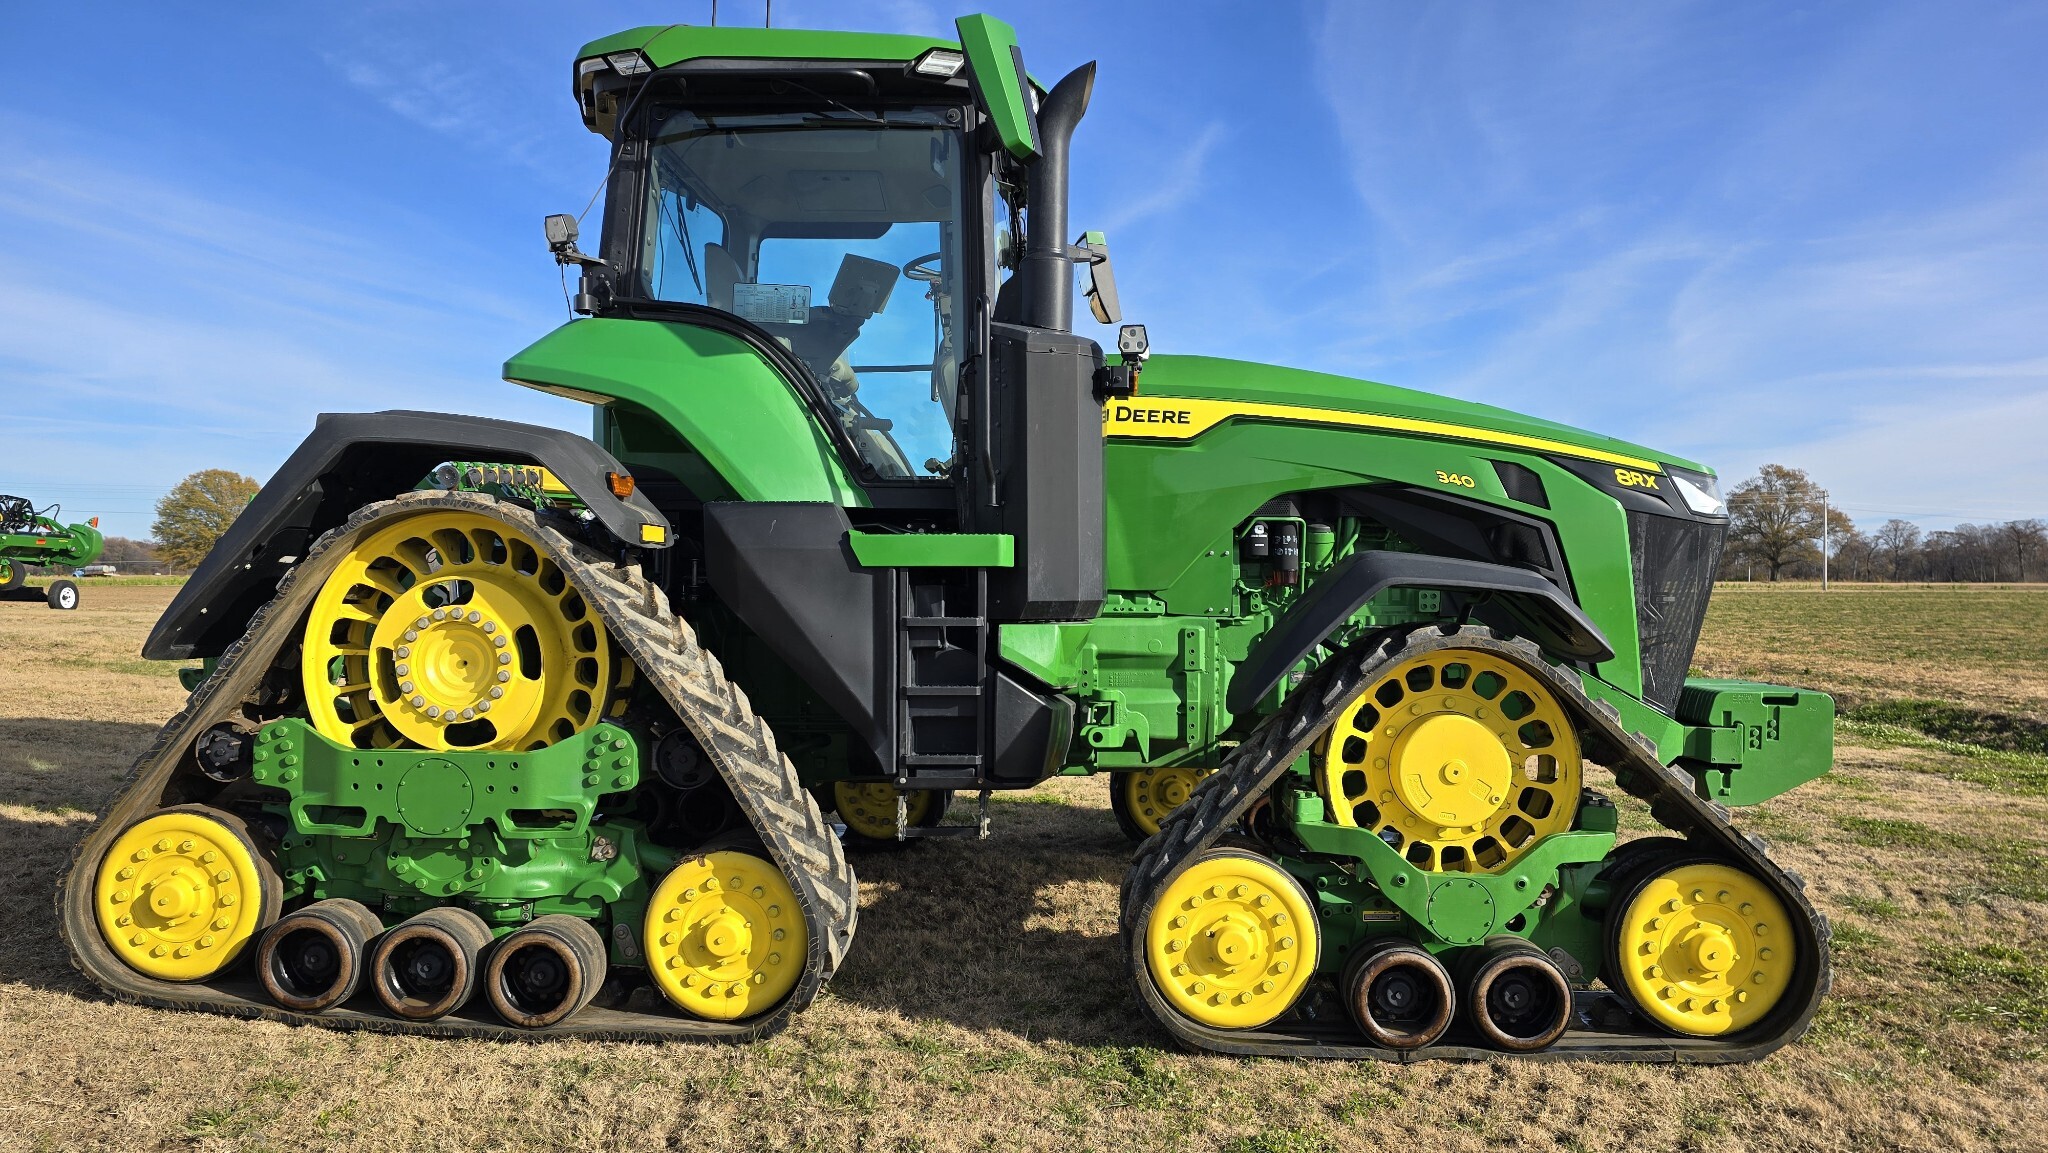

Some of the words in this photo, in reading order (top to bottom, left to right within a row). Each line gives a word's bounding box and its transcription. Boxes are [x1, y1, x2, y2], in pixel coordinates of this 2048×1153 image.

[1115, 406, 1191, 424] DEERE
[1434, 470, 1476, 489] 340
[1614, 468, 1660, 490] 8RX
